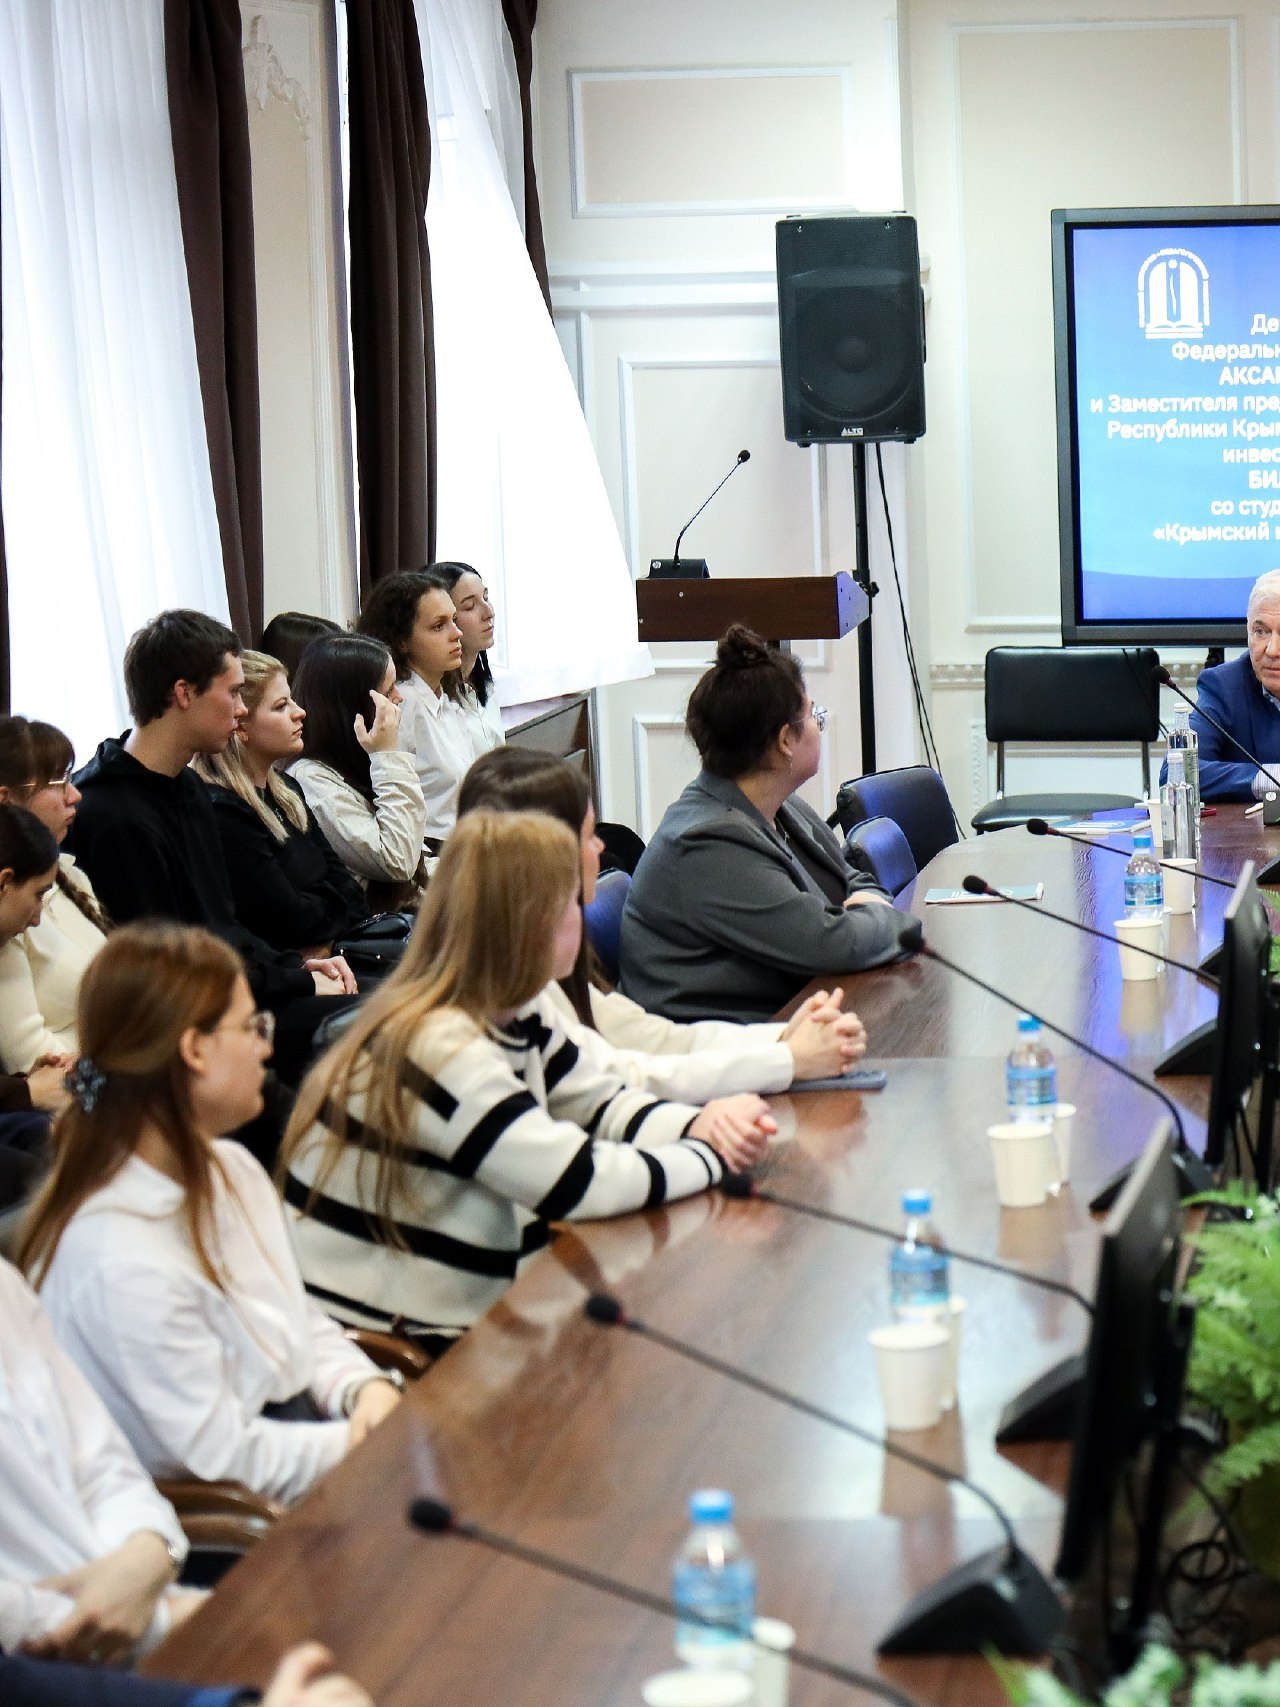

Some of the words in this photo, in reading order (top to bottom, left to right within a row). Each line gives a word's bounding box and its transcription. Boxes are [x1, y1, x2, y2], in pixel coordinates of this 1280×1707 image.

[1090, 398, 1103, 413] и
[1108, 394, 1238, 414] Заместителя
[841, 427, 864, 436] ALTO
[1107, 418, 1228, 443] Республики
[1210, 500, 1235, 516] со
[1153, 521, 1270, 545] «Крымский
